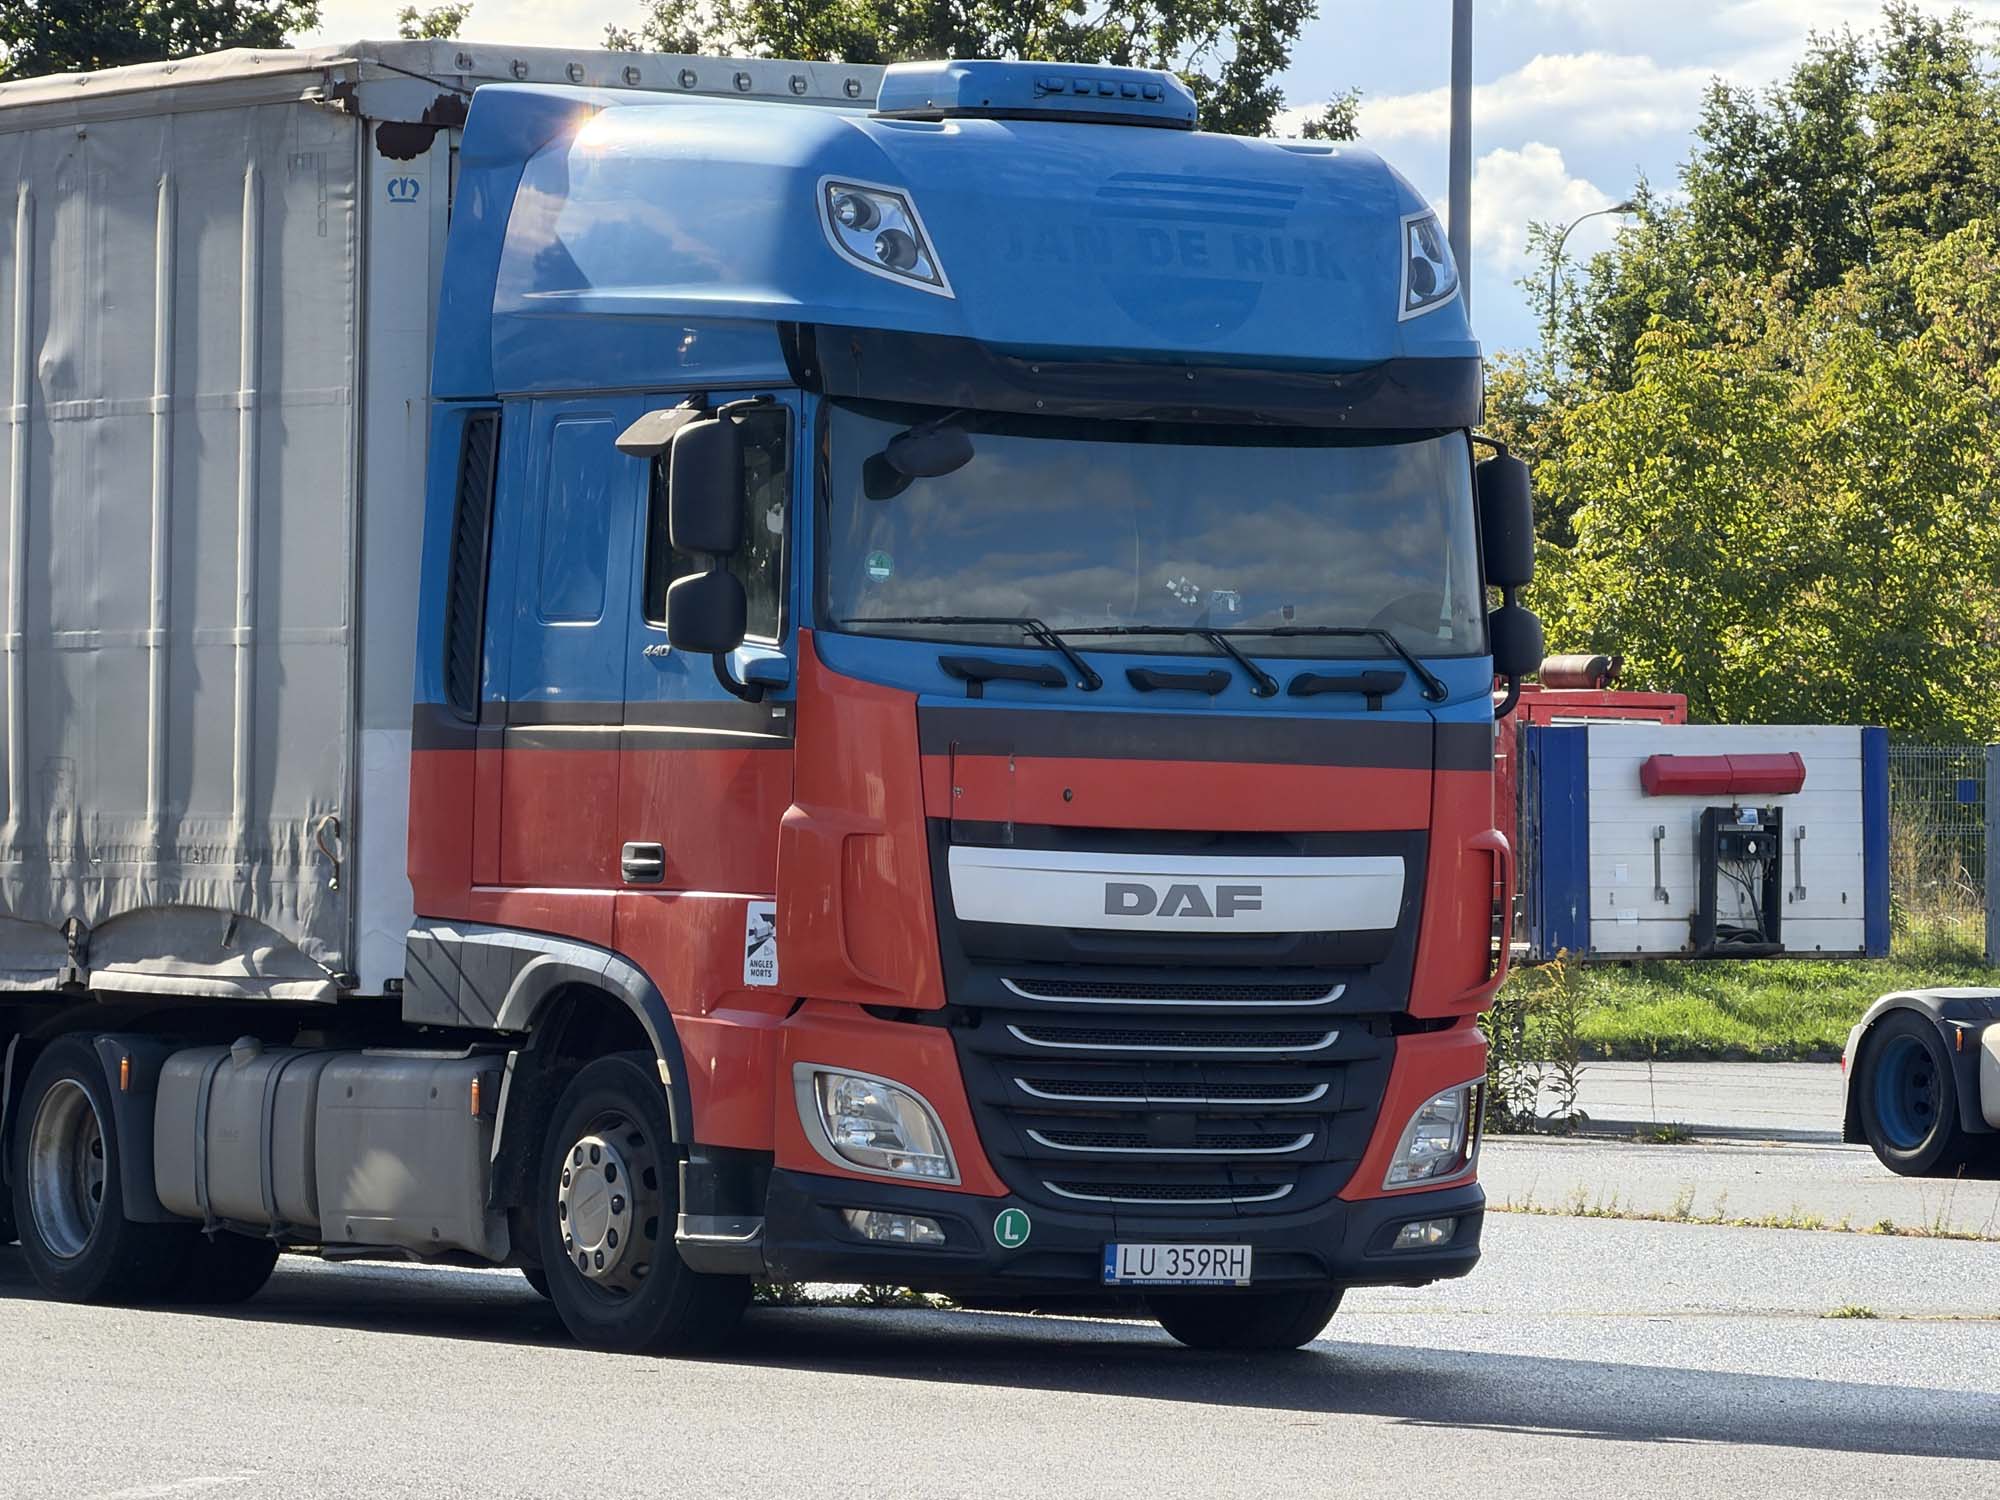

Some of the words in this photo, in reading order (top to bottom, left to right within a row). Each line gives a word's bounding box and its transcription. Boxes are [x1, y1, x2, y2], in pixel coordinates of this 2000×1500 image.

[1136, 227, 1209, 268] DE
[642, 644, 671, 657] 440
[1105, 882, 1262, 918] DAF
[750, 960, 773, 968] ANGLES
[751, 969, 772, 977] MORTS
[1005, 1216, 1018, 1240] L
[1105, 1264, 1115, 1273] PL
[1123, 1247, 1156, 1276] LU
[1166, 1248, 1245, 1277] 359RH
